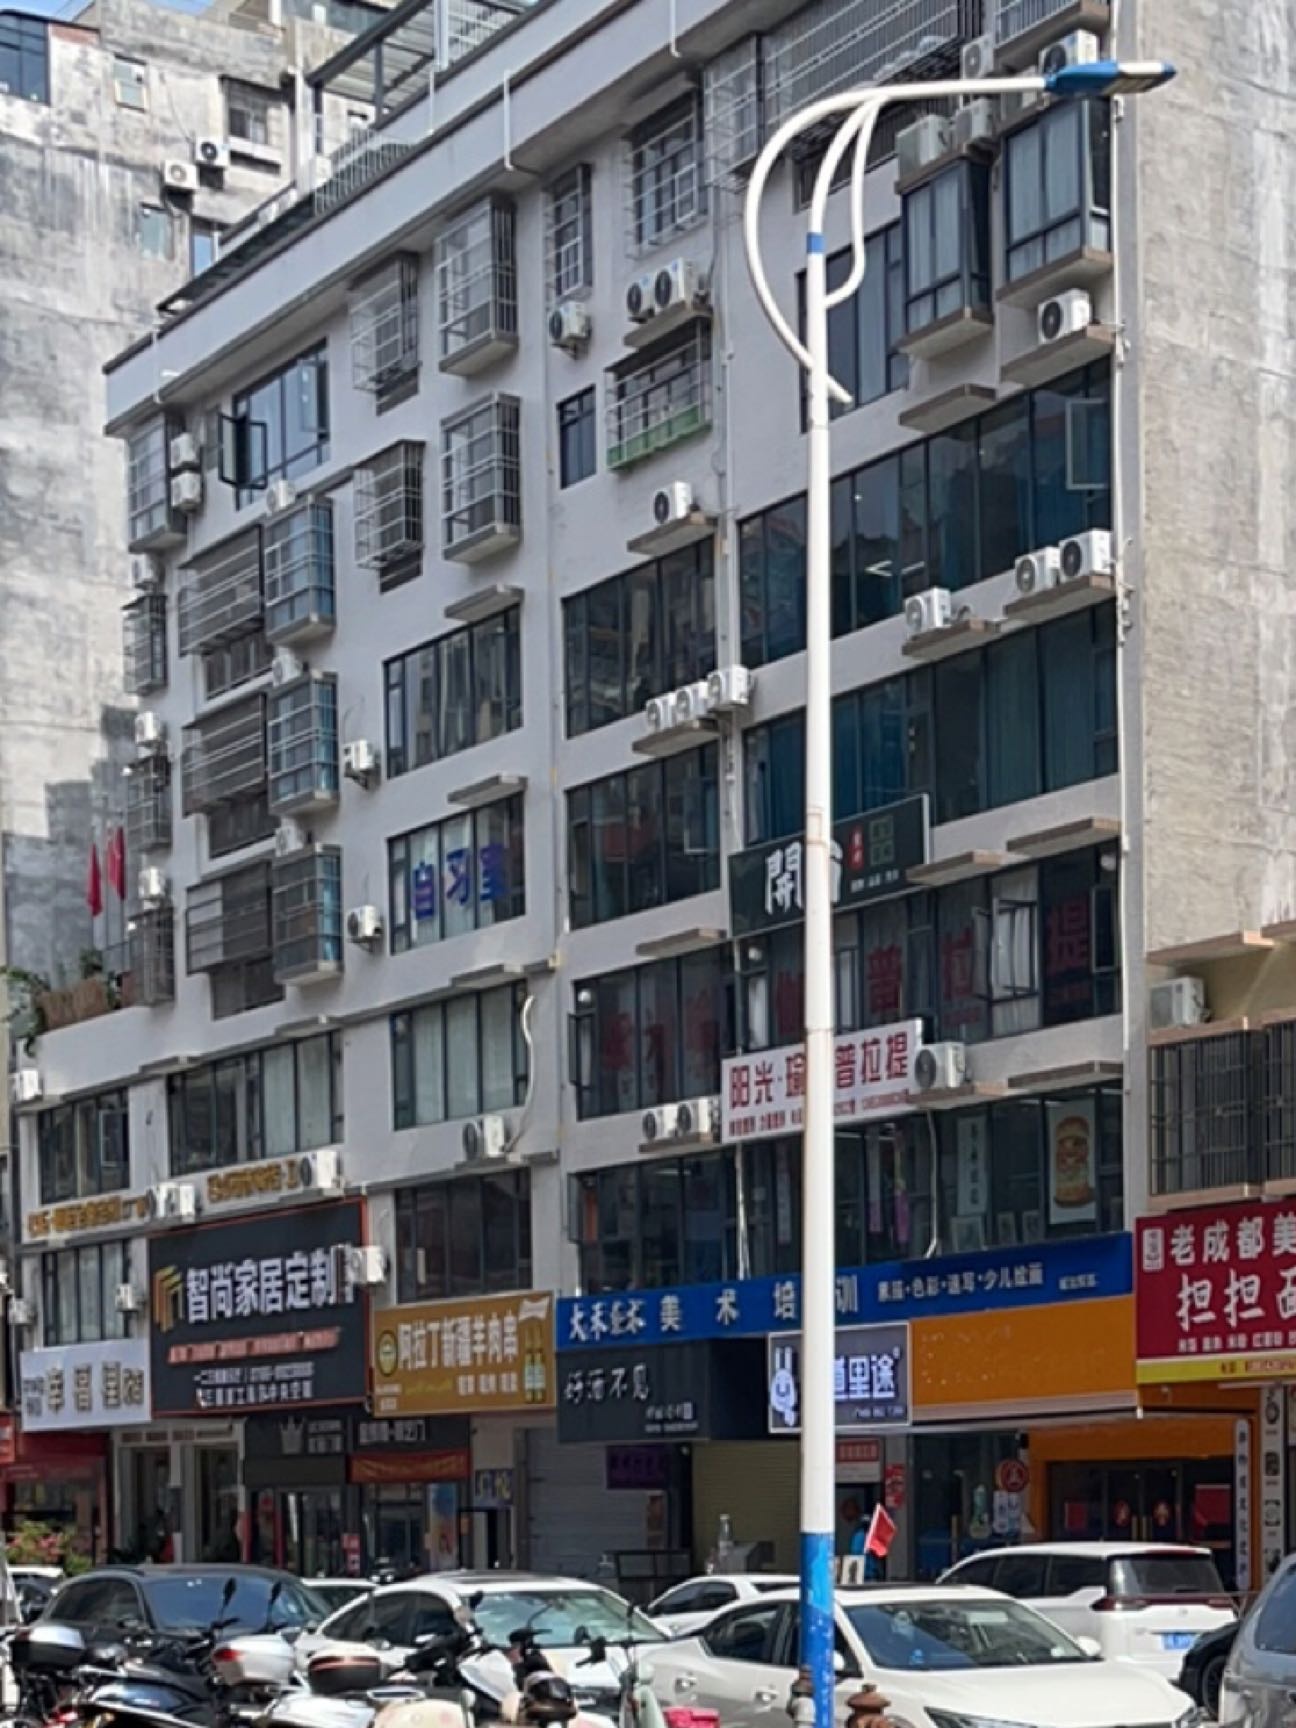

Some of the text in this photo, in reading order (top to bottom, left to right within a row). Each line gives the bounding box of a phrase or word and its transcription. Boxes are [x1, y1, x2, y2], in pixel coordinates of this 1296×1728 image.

[730, 1031, 908, 1110] 阳光·瑜普拉提
